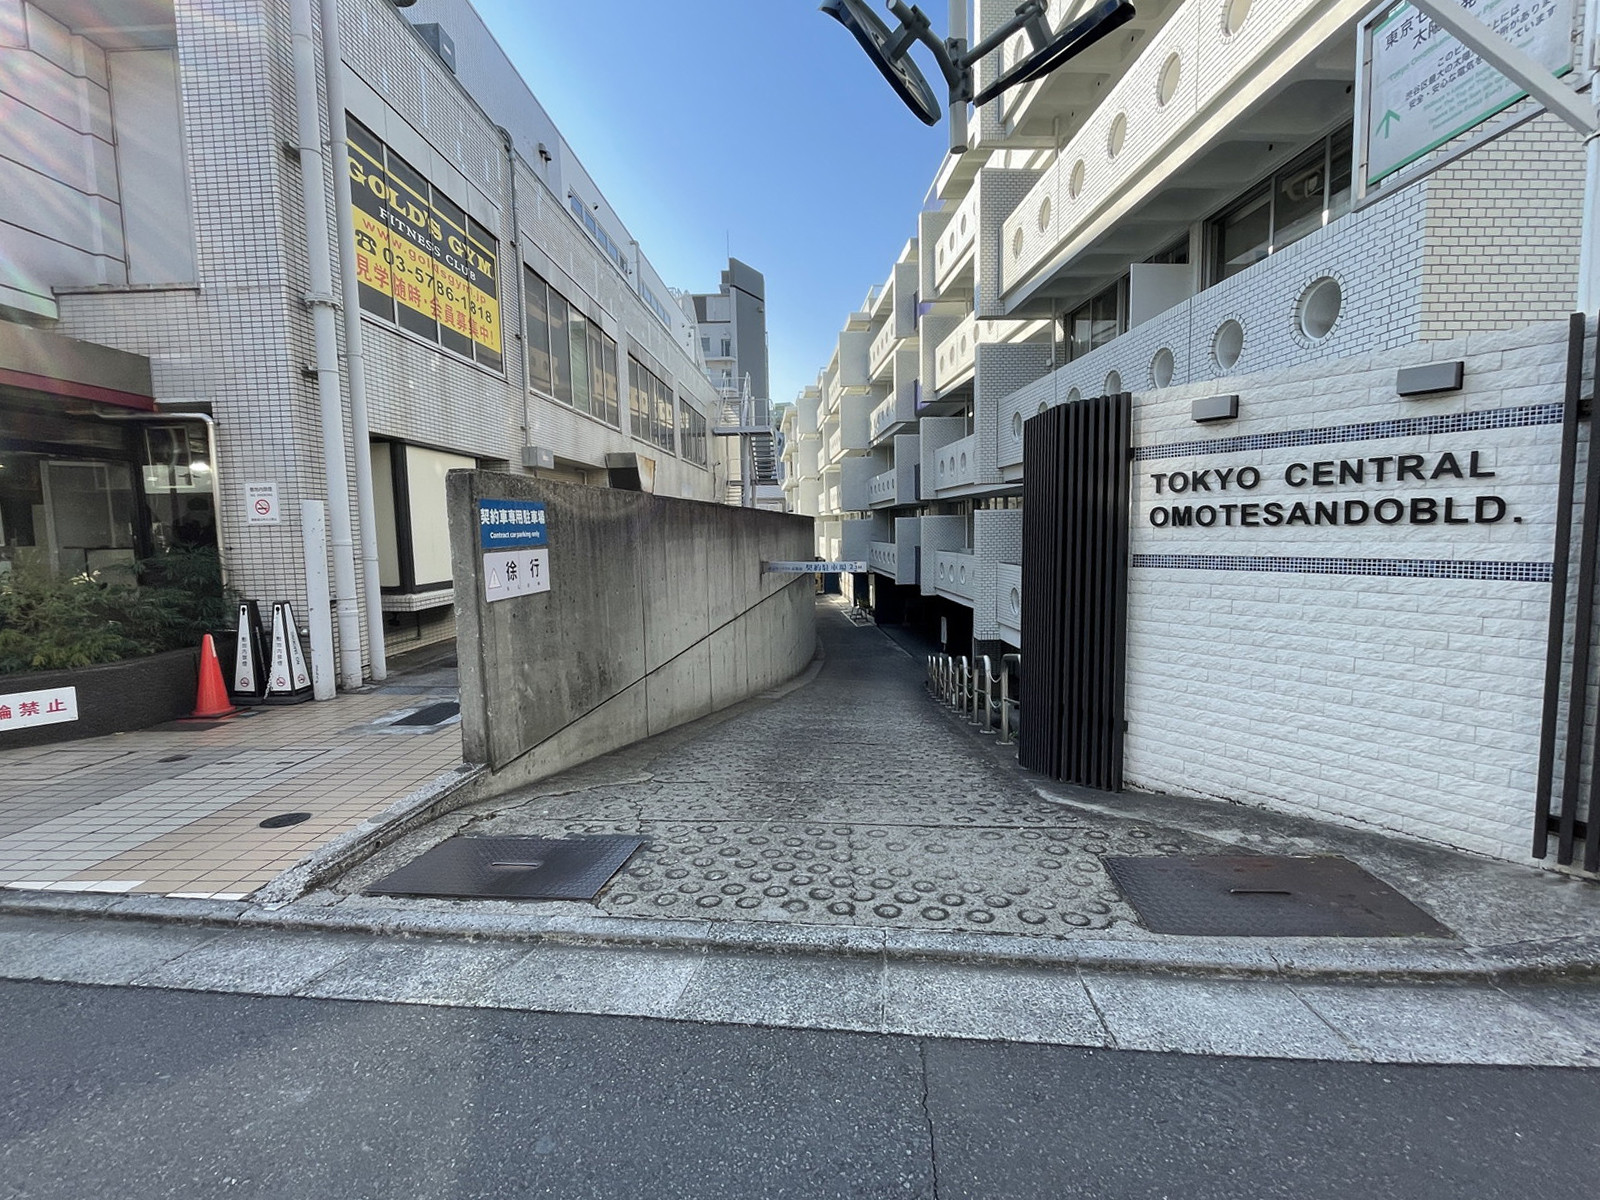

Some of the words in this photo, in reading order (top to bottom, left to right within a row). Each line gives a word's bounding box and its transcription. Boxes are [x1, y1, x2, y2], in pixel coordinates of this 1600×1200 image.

[348, 156, 443, 242] GOLD'S
[448, 235, 495, 279] GYM
[379, 206, 441, 257] FITNESS
[445, 254, 477, 281] CLUB
[362, 218, 486, 305] www.goldsgym.jp
[383, 247, 492, 324] 03-5786-1818
[1151, 465, 1261, 494] TOKYO
[1284, 450, 1496, 488] CENTRAL
[480, 508, 546, 525] 契約車専用駐車場
[516, 531, 531, 539] parking
[505, 558, 540, 582] 徐行
